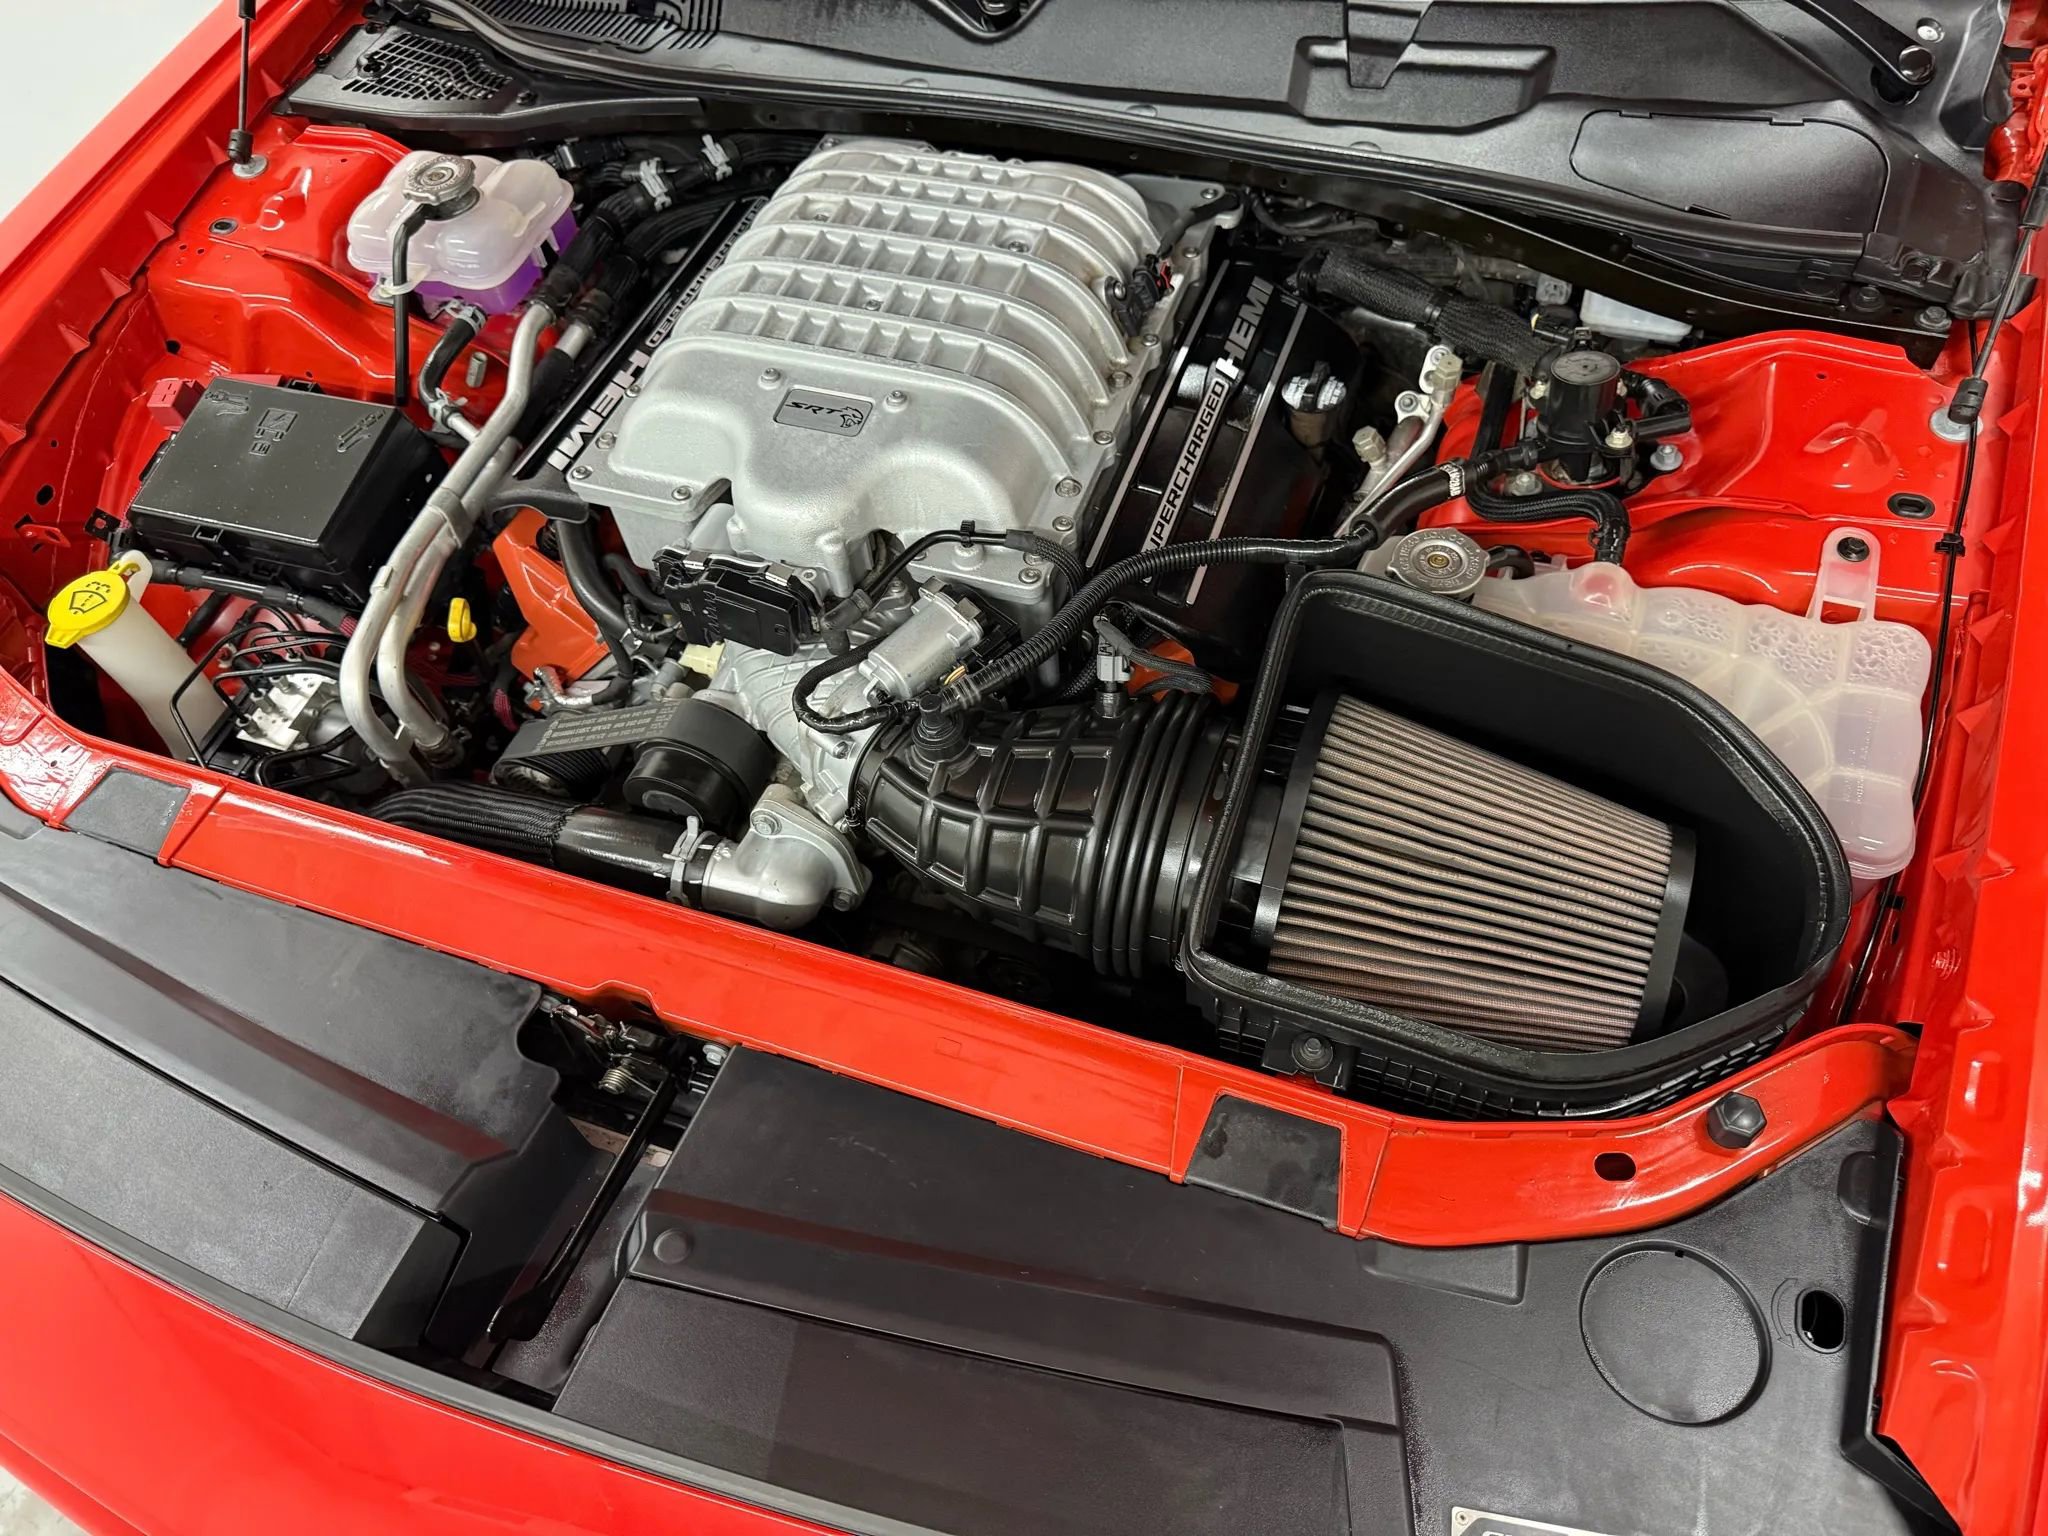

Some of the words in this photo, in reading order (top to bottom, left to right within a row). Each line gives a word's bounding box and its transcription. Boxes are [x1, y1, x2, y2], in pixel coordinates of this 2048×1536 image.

[547, 350, 650, 471] HEMI
[785, 402, 842, 414] SRT
[1149, 380, 1225, 550] PERCHARGED
[1215, 276, 1275, 379] HEMI
